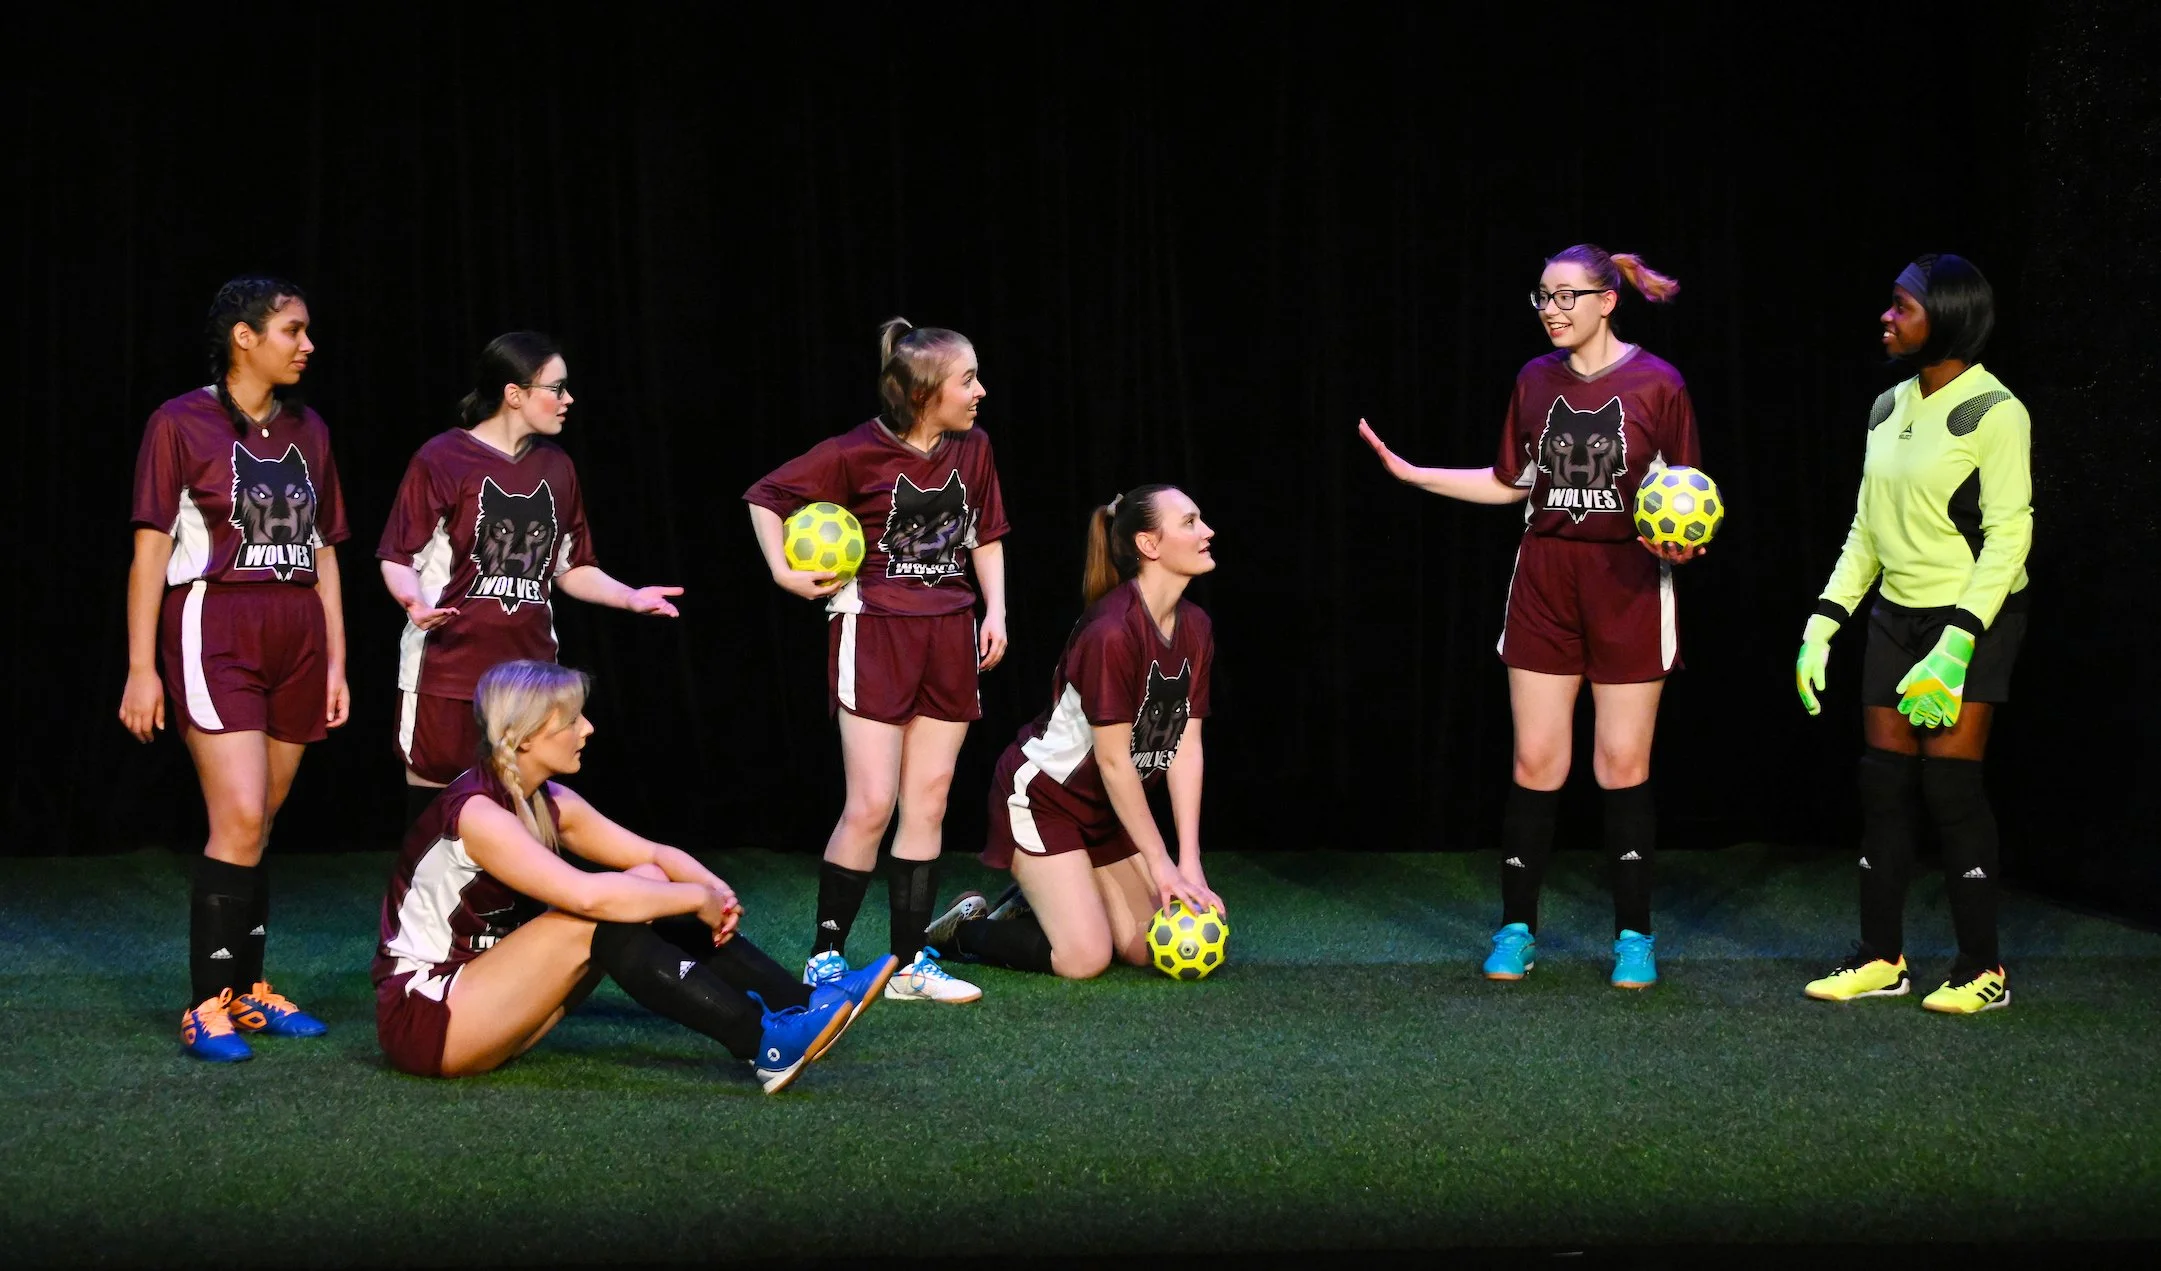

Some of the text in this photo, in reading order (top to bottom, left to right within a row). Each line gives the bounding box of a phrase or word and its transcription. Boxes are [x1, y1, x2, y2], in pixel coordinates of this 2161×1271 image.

[1546, 488, 1617, 509] WOLVES
[244, 544, 310, 567] WOLVES
[475, 576, 540, 600] WOLVES
